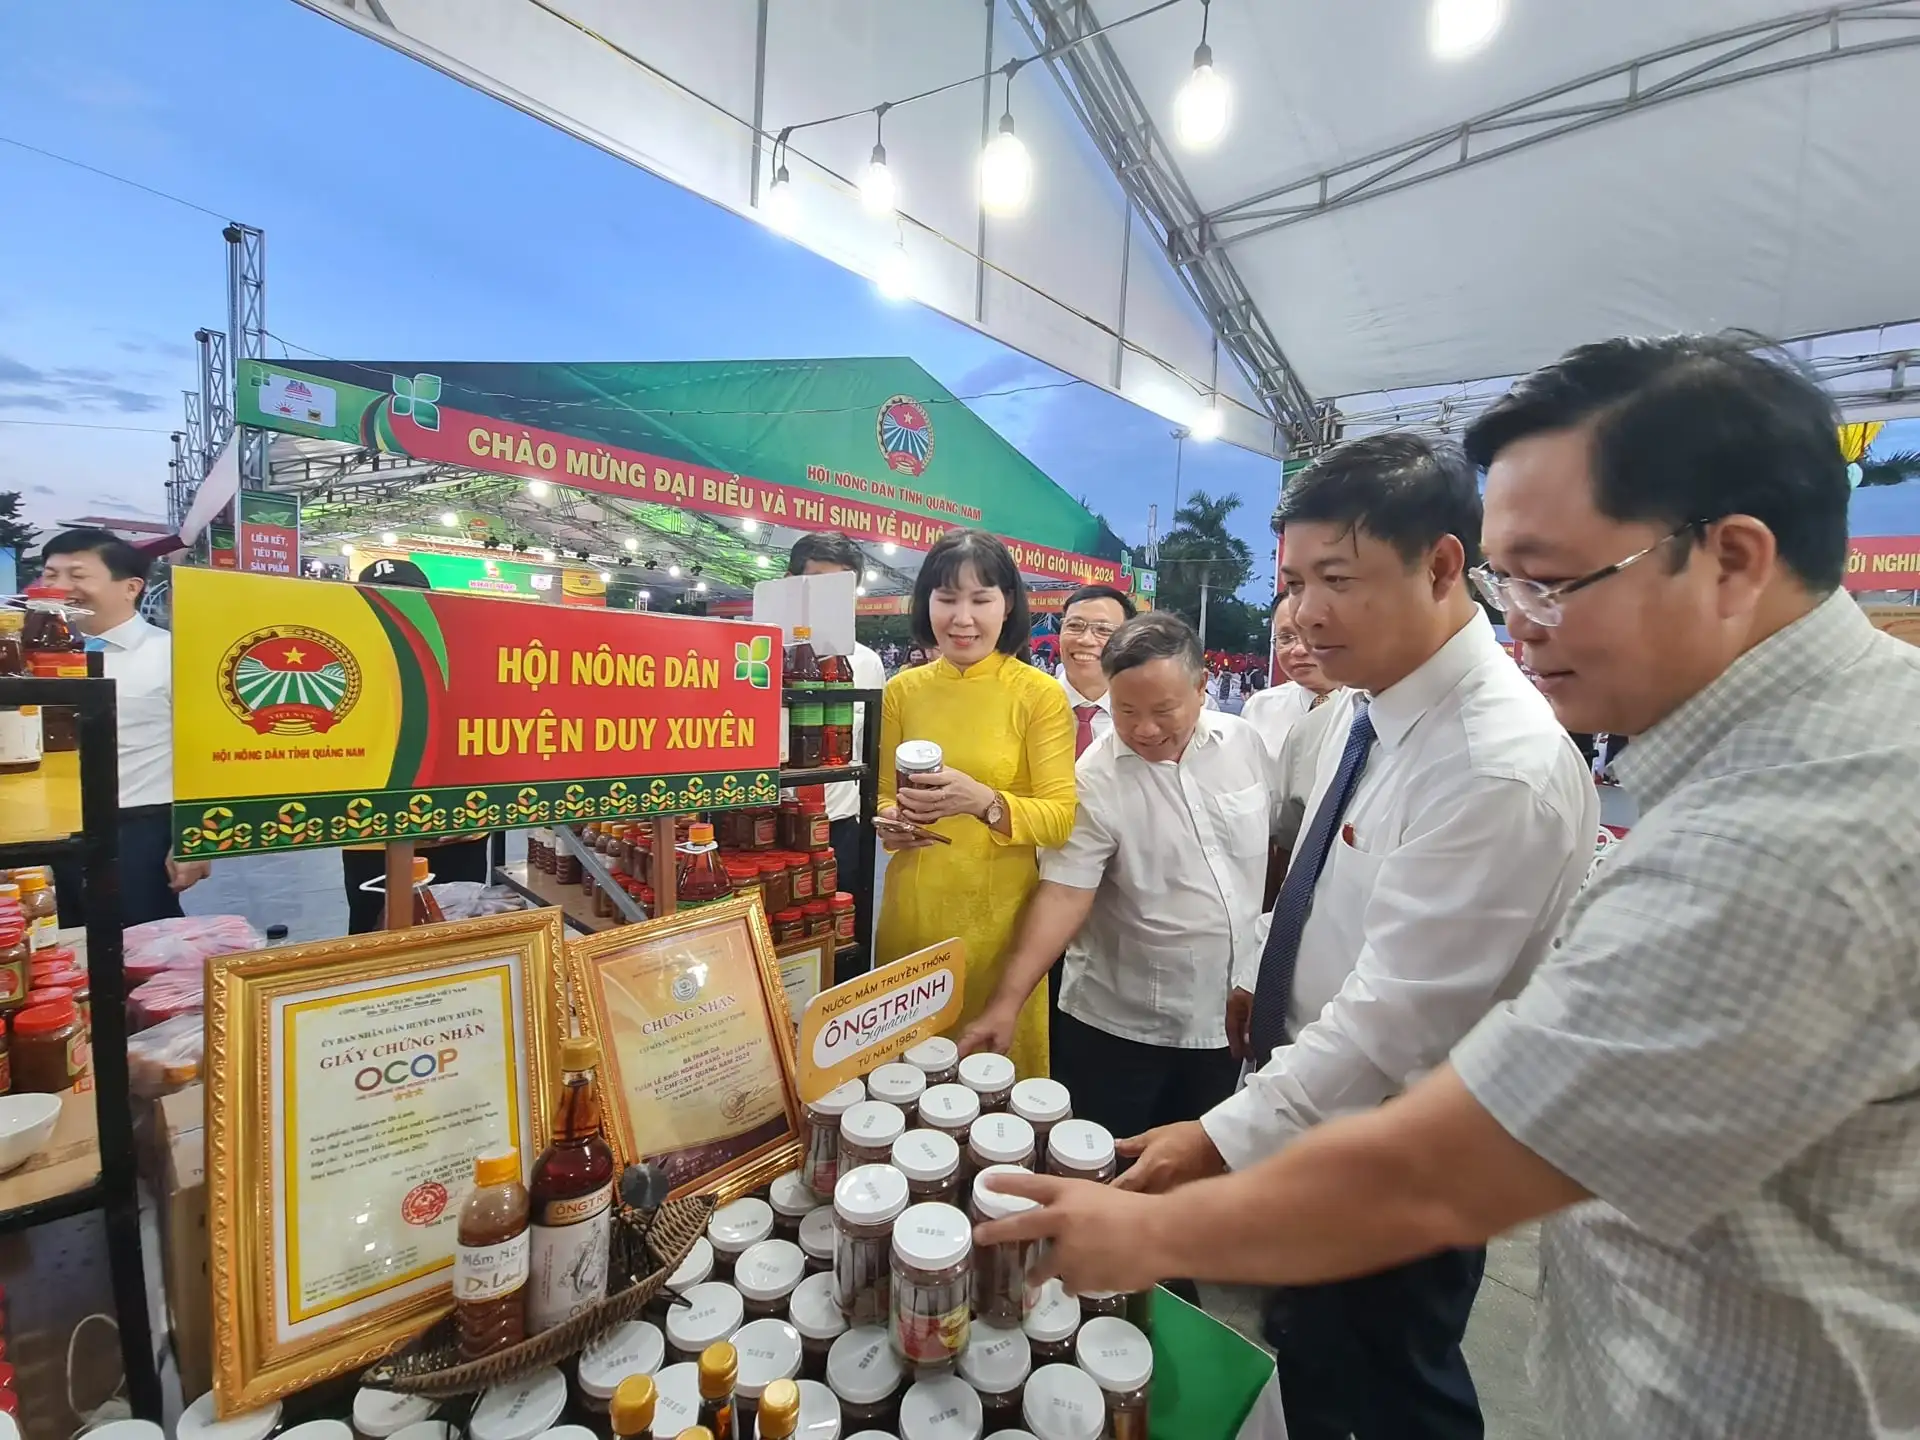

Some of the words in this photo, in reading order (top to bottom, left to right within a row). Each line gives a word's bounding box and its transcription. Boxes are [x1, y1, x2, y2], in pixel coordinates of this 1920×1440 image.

[468, 428, 557, 470] CHÀO
[566, 448, 646, 489] MỪNG
[653, 467, 696, 502] ĐẠI
[702, 473, 754, 510] BIỂU
[760, 488, 787, 517] VÀ
[793, 498, 824, 523] THÍ
[829, 505, 871, 532] SINH
[876, 510, 897, 537] VỀ
[901, 520, 923, 546] DỰ
[1026, 548, 1045, 573] HỘI
[1048, 553, 1069, 575] GIỎI
[1071, 559, 1092, 579] NĂM
[1094, 567, 1115, 583] 2024
[807, 464, 830, 485] HỘI
[834, 472, 868, 492] NÔNG
[871, 480, 895, 499] DÂN
[900, 485, 923, 506] TỈNH
[926, 495, 958, 515] QUẢNG
[961, 504, 982, 521] NAM
[250, 532, 270, 544] LIÊN
[252, 546, 271, 558] TIÊU
[250, 559, 267, 571] SẢN
[268, 560, 290, 573] PHẨM
[1848, 548, 1868, 574] ỞI
[497, 638, 560, 692] HỘI
[572, 643, 655, 688] NÔNG
[664, 648, 719, 689] DÂN
[212, 748, 231, 763] HỘI
[234, 747, 263, 761] NÔNG
[264, 747, 285, 760] DÂN
[288, 745, 310, 760] TỈNH
[313, 744, 344, 760] QUẢNG
[346, 747, 365, 758] NAM
[458, 707, 584, 761] HUYỆN
[595, 717, 657, 752] DUY
[665, 708, 755, 750] XUYÊN
[821, 993, 852, 1016] NƯỚC
[855, 981, 878, 1001] MẮM
[881, 965, 920, 989] TRUYỀN
[921, 951, 951, 971] THỐNG
[337, 1034, 357, 1045] BAN
[358, 1027, 384, 1040] NHÂN
[385, 1022, 404, 1034] DÂN
[406, 1017, 436, 1030] HUYỆN
[437, 1012, 455, 1023] DUY
[456, 1007, 484, 1019] XUYÊN
[642, 1008, 695, 1035] CHỨNG
[698, 994, 736, 1016] NHẬN
[824, 974, 946, 1048] ÔNGTRINH
[855, 1005, 921, 1047] Signature
[320, 1045, 367, 1069] GIẤY
[373, 1034, 435, 1058] CHỨNG
[439, 1023, 486, 1043] NHẬN
[858, 1053, 871, 1068] TỪ
[873, 1045, 893, 1058] NĂM
[354, 1047, 458, 1092] OCOP
[654, 1074, 693, 1095] TECHFEST
[555, 1189, 611, 1216] ÔNGTR
